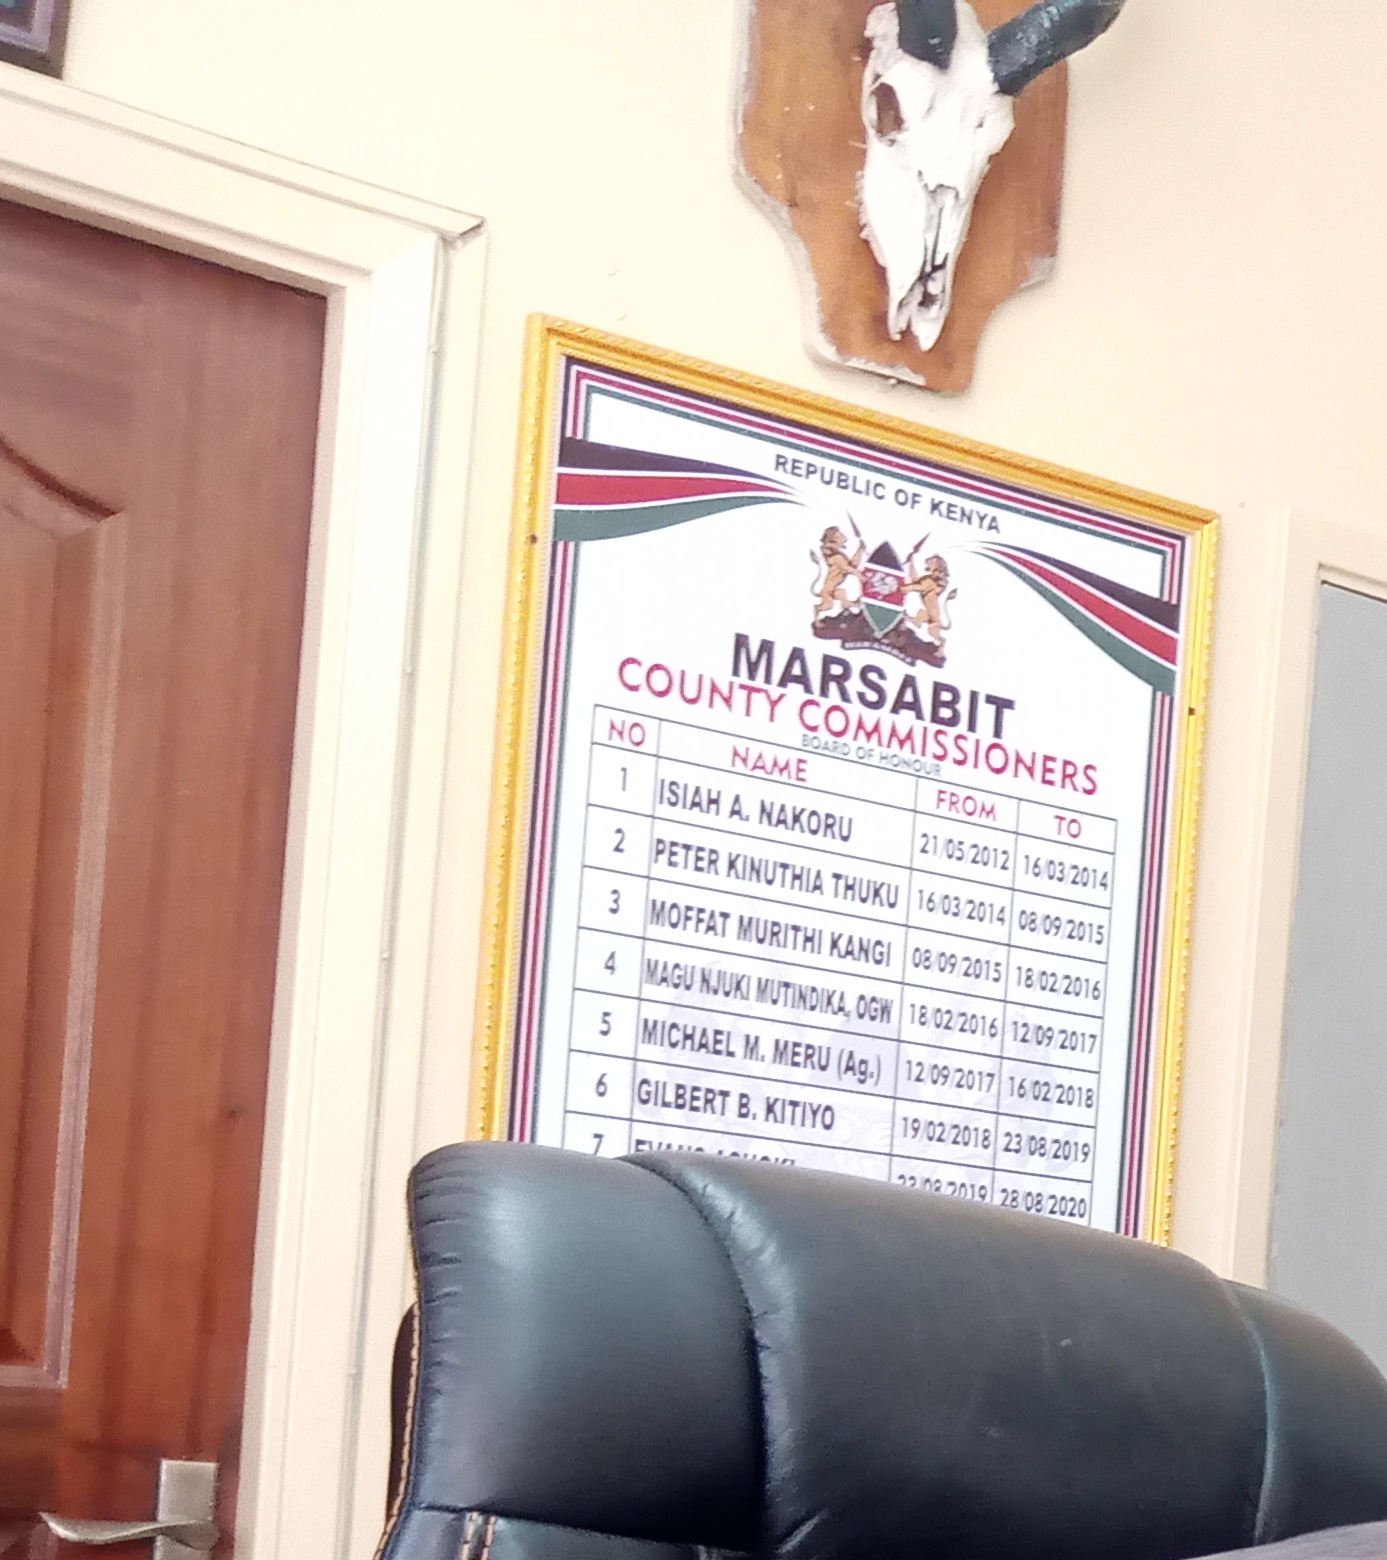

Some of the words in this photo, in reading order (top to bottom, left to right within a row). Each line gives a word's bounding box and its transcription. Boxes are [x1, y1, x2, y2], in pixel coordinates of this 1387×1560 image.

[775, 454, 885, 500] REPUBLIC
[894, 488, 921, 509] OF
[930, 498, 1001, 533] KENYA
[618, 657, 786, 722] COUNTY
[798, 699, 1098, 795] COMMISSIONERS
[732, 633, 1015, 739] MARSABIT
[608, 718, 646, 747] NO
[731, 744, 808, 782] NAME
[936, 789, 997, 821] FROM
[1054, 815, 1082, 838] TO
[802, 733, 850, 756] BOARD
[855, 746, 875, 762] OF
[879, 752, 942, 777] HONOUR
[620, 767, 627, 791] 1
[659, 779, 721, 816] ISIAH
[729, 794, 750, 822] A.
[758, 799, 853, 842] NAKORU
[919, 833, 1010, 871] 21/05/2012
[1024, 855, 1109, 891] 16/03/2014
[612, 828, 625, 853] 2
[654, 838, 719, 876] PETER
[726, 852, 824, 895] KINUTHIA
[832, 872, 900, 909] THUKU
[917, 889, 1006, 926] 16/03/2014
[1018, 910, 1105, 945] 08/09/2015
[609, 889, 621, 914] 3
[650, 899, 731, 938] MOFFAT
[736, 915, 822, 954] MURITHI
[829, 931, 892, 967] KANGI
[912, 947, 1002, 983] 08/09/2015
[1016, 966, 1101, 1000] 18/02/2016
[604, 951, 617, 975] 4
[644, 958, 696, 991] MAGU
[700, 967, 751, 1001] NJUKI
[856, 994, 894, 1024] OGW
[909, 1003, 999, 1038] 18/02/2016
[1012, 1021, 1097, 1054] 12/09/2017
[599, 1011, 612, 1036] 5
[641, 1018, 735, 1058] MICHAEL
[743, 1034, 765, 1063] M.
[772, 1038, 831, 1072] MERU
[837, 1048, 882, 1086] (Ag.)
[906, 1059, 995, 1093] 12/09/2017
[1008, 1076, 1094, 1109] 16/02/2018
[592, 1133, 605, 1156] 7
[595, 1072, 608, 1098] 6
[638, 1078, 730, 1116] GILBERT
[737, 1092, 757, 1121] B.
[764, 1096, 835, 1131] KITIYO
[902, 1116, 991, 1150] 19/02/2018
[1003, 1131, 1091, 1163] 23/08/2019
